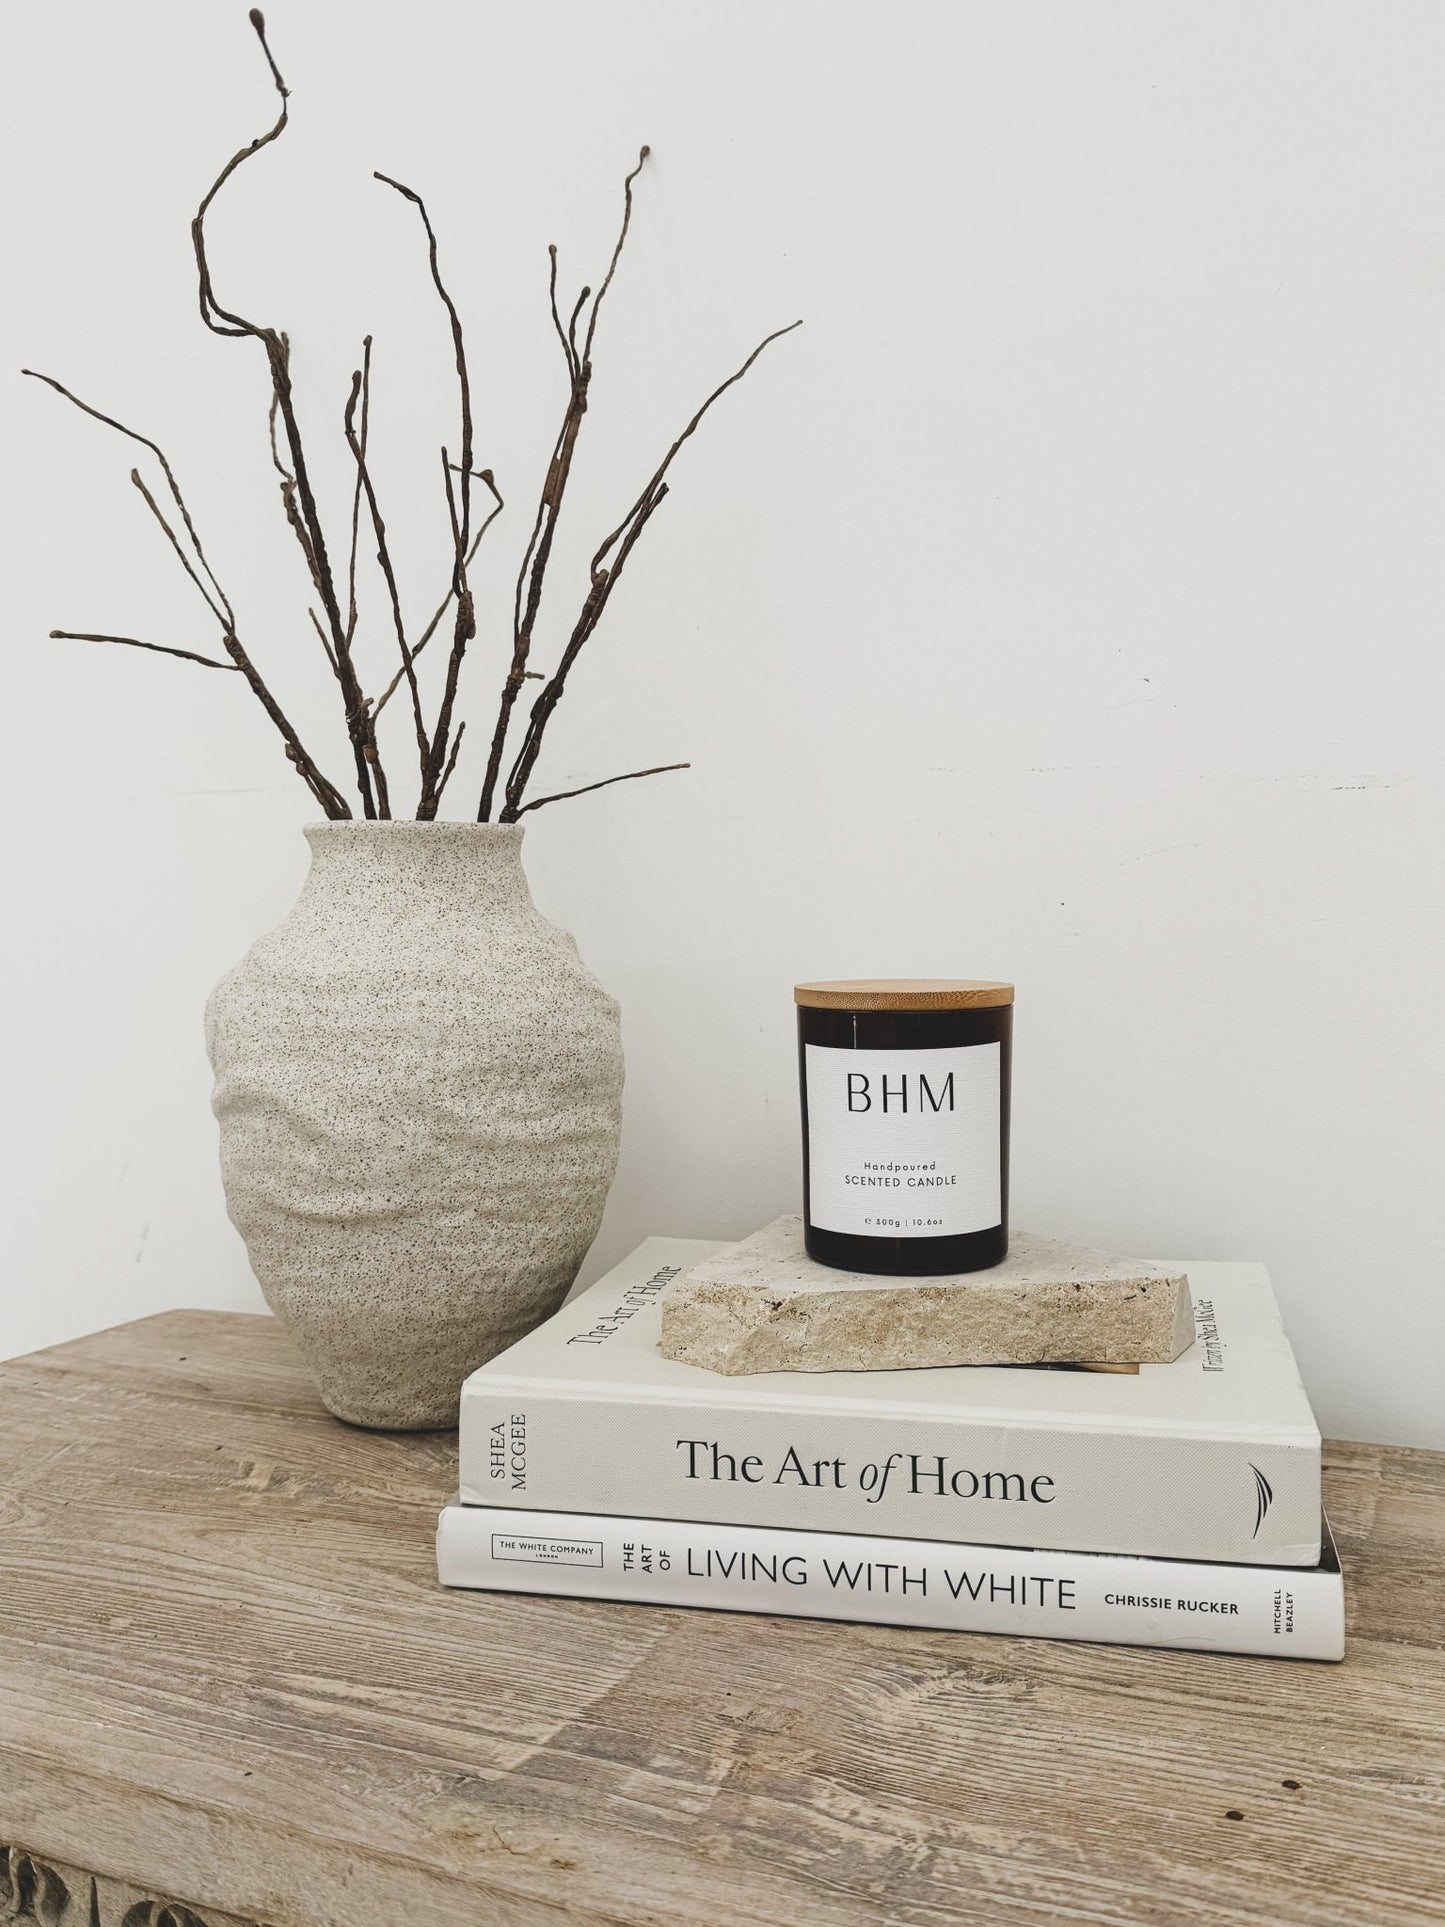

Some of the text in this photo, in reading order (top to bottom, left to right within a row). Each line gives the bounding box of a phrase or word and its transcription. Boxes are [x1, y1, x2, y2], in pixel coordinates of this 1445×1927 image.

[847, 1071, 955, 1114] BHM
[845, 1174, 957, 1188] SCENTED CANDLE
[863, 1160, 936, 1172] Handpoured
[876, 1218, 901, 1228] 300g
[912, 1218, 943, 1226] 10.6oz
[565, 1265, 682, 1345] The Art of Home
[1197, 1324, 1220, 1341] Shea
[490, 1422, 506, 1479] SHEA
[510, 1414, 527, 1490] MCGEE
[676, 1439, 1056, 1504] The Art of Home
[499, 1540, 594, 1556] THE WHITE COMPANY
[623, 1542, 635, 1572] THE
[641, 1543, 653, 1574] ART
[659, 1550, 671, 1571] OF
[687, 1547, 1076, 1610] LIVING WITH WHITE
[1104, 1593, 1239, 1615] CHRISSIE RUCKER
[1273, 1589, 1282, 1634] MITCHELL
[1285, 1592, 1294, 1633] BEAZLEY
